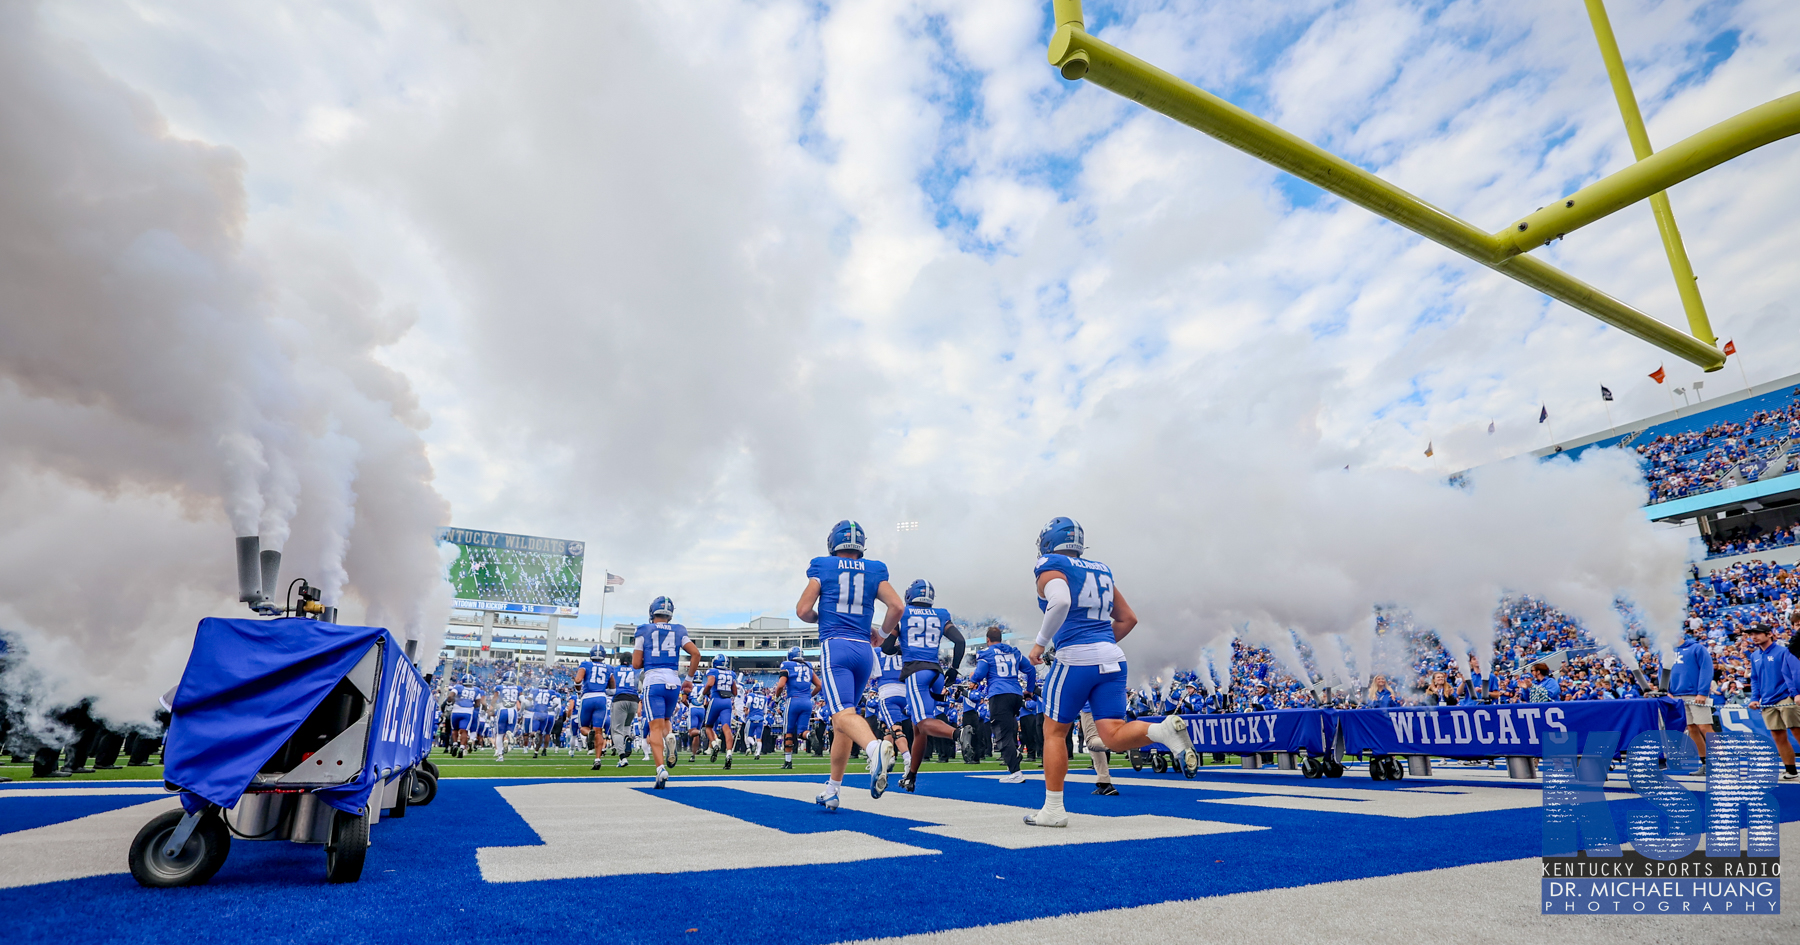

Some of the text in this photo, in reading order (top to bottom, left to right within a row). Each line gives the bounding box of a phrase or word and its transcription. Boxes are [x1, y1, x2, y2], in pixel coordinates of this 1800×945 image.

[446, 529, 565, 553] NTUCKY WILDCATS
[838, 559, 865, 571] ALLEN
[836, 571, 865, 615] 11
[1077, 571, 1114, 621] 42
[908, 608, 937, 616] PURCELL
[907, 616, 941, 648] 26
[651, 630, 677, 657] 14
[794, 665, 811, 682] 73
[994, 653, 1017, 677] 67
[589, 666, 607, 685] 15
[617, 671, 635, 687] 74
[717, 673, 733, 692] 22
[535, 692, 550, 705] 46
[752, 696, 765, 710] 93
[1193, 707, 1569, 746] NTUCKY WILDCATS
